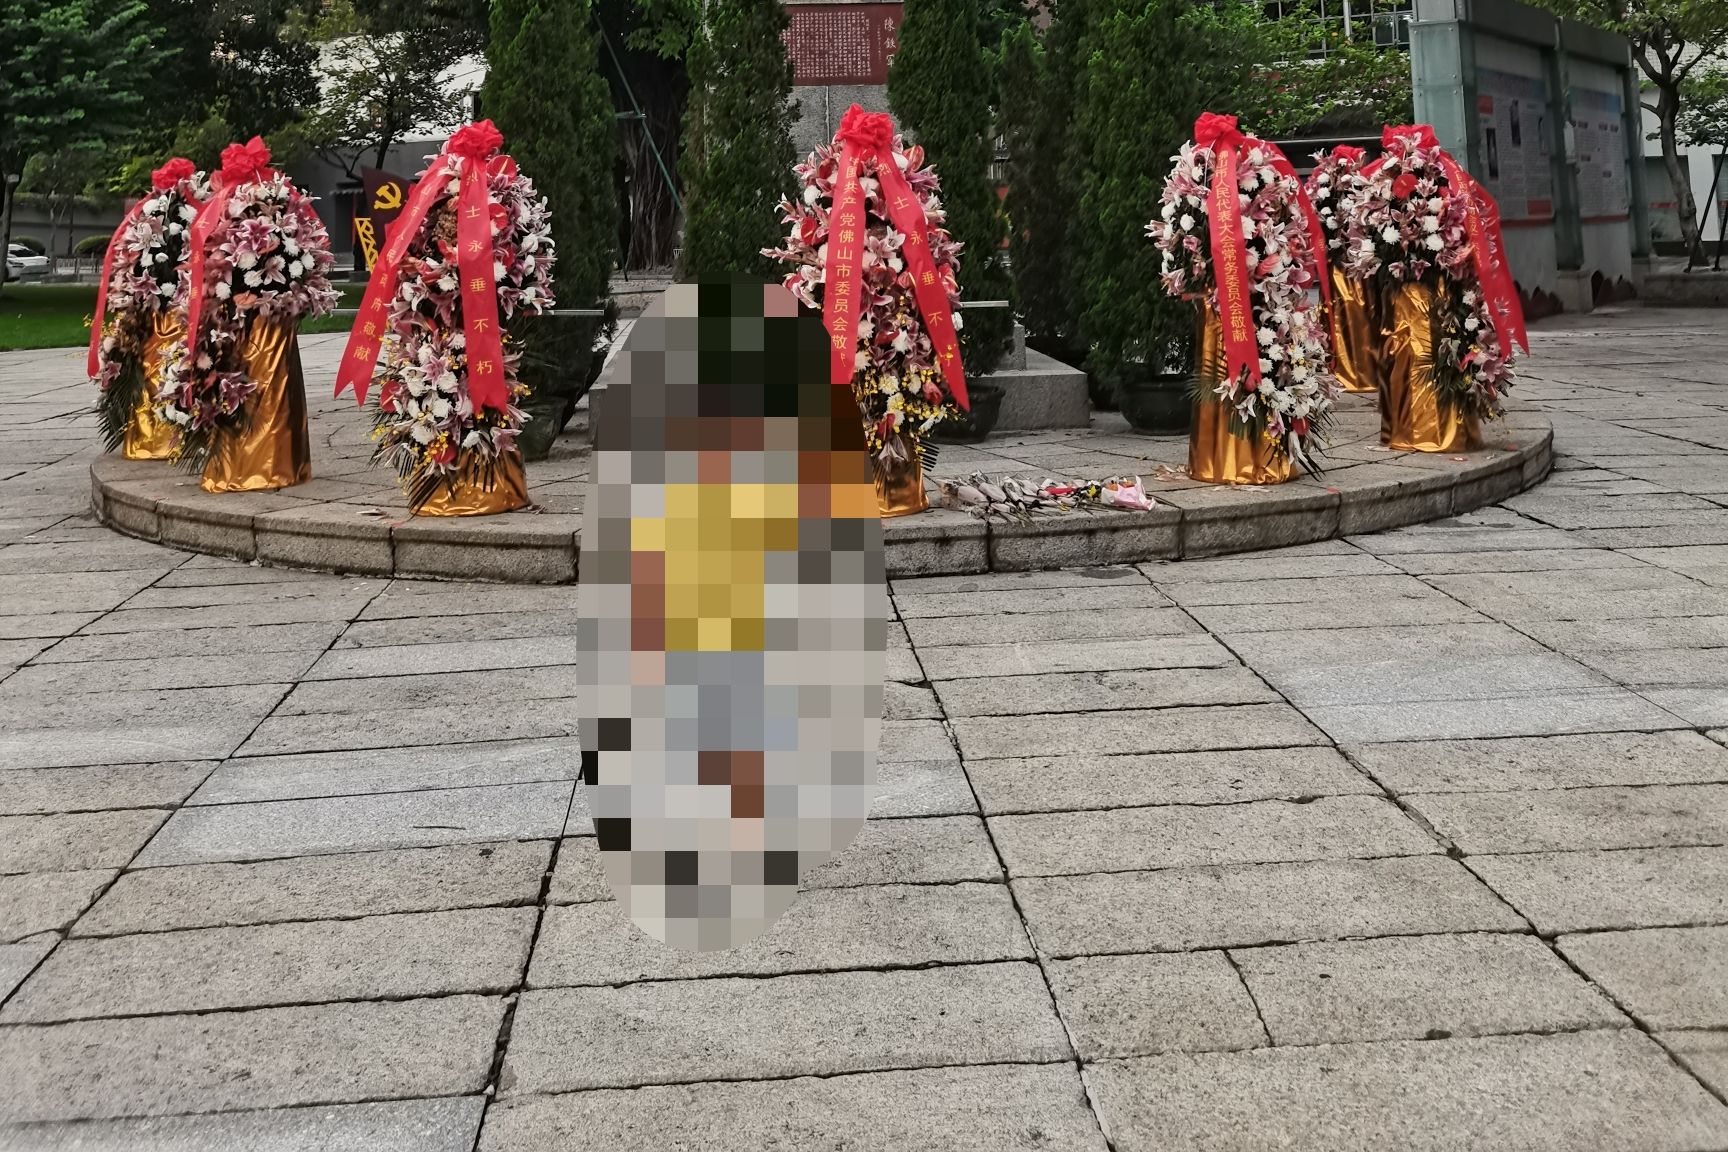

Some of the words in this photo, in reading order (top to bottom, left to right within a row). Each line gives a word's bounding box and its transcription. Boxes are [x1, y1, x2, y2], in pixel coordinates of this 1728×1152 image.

[464, 170, 493, 376] 烈士永垂不朽
[832, 155, 860, 367] 中国共产党佛山市委员会敬
